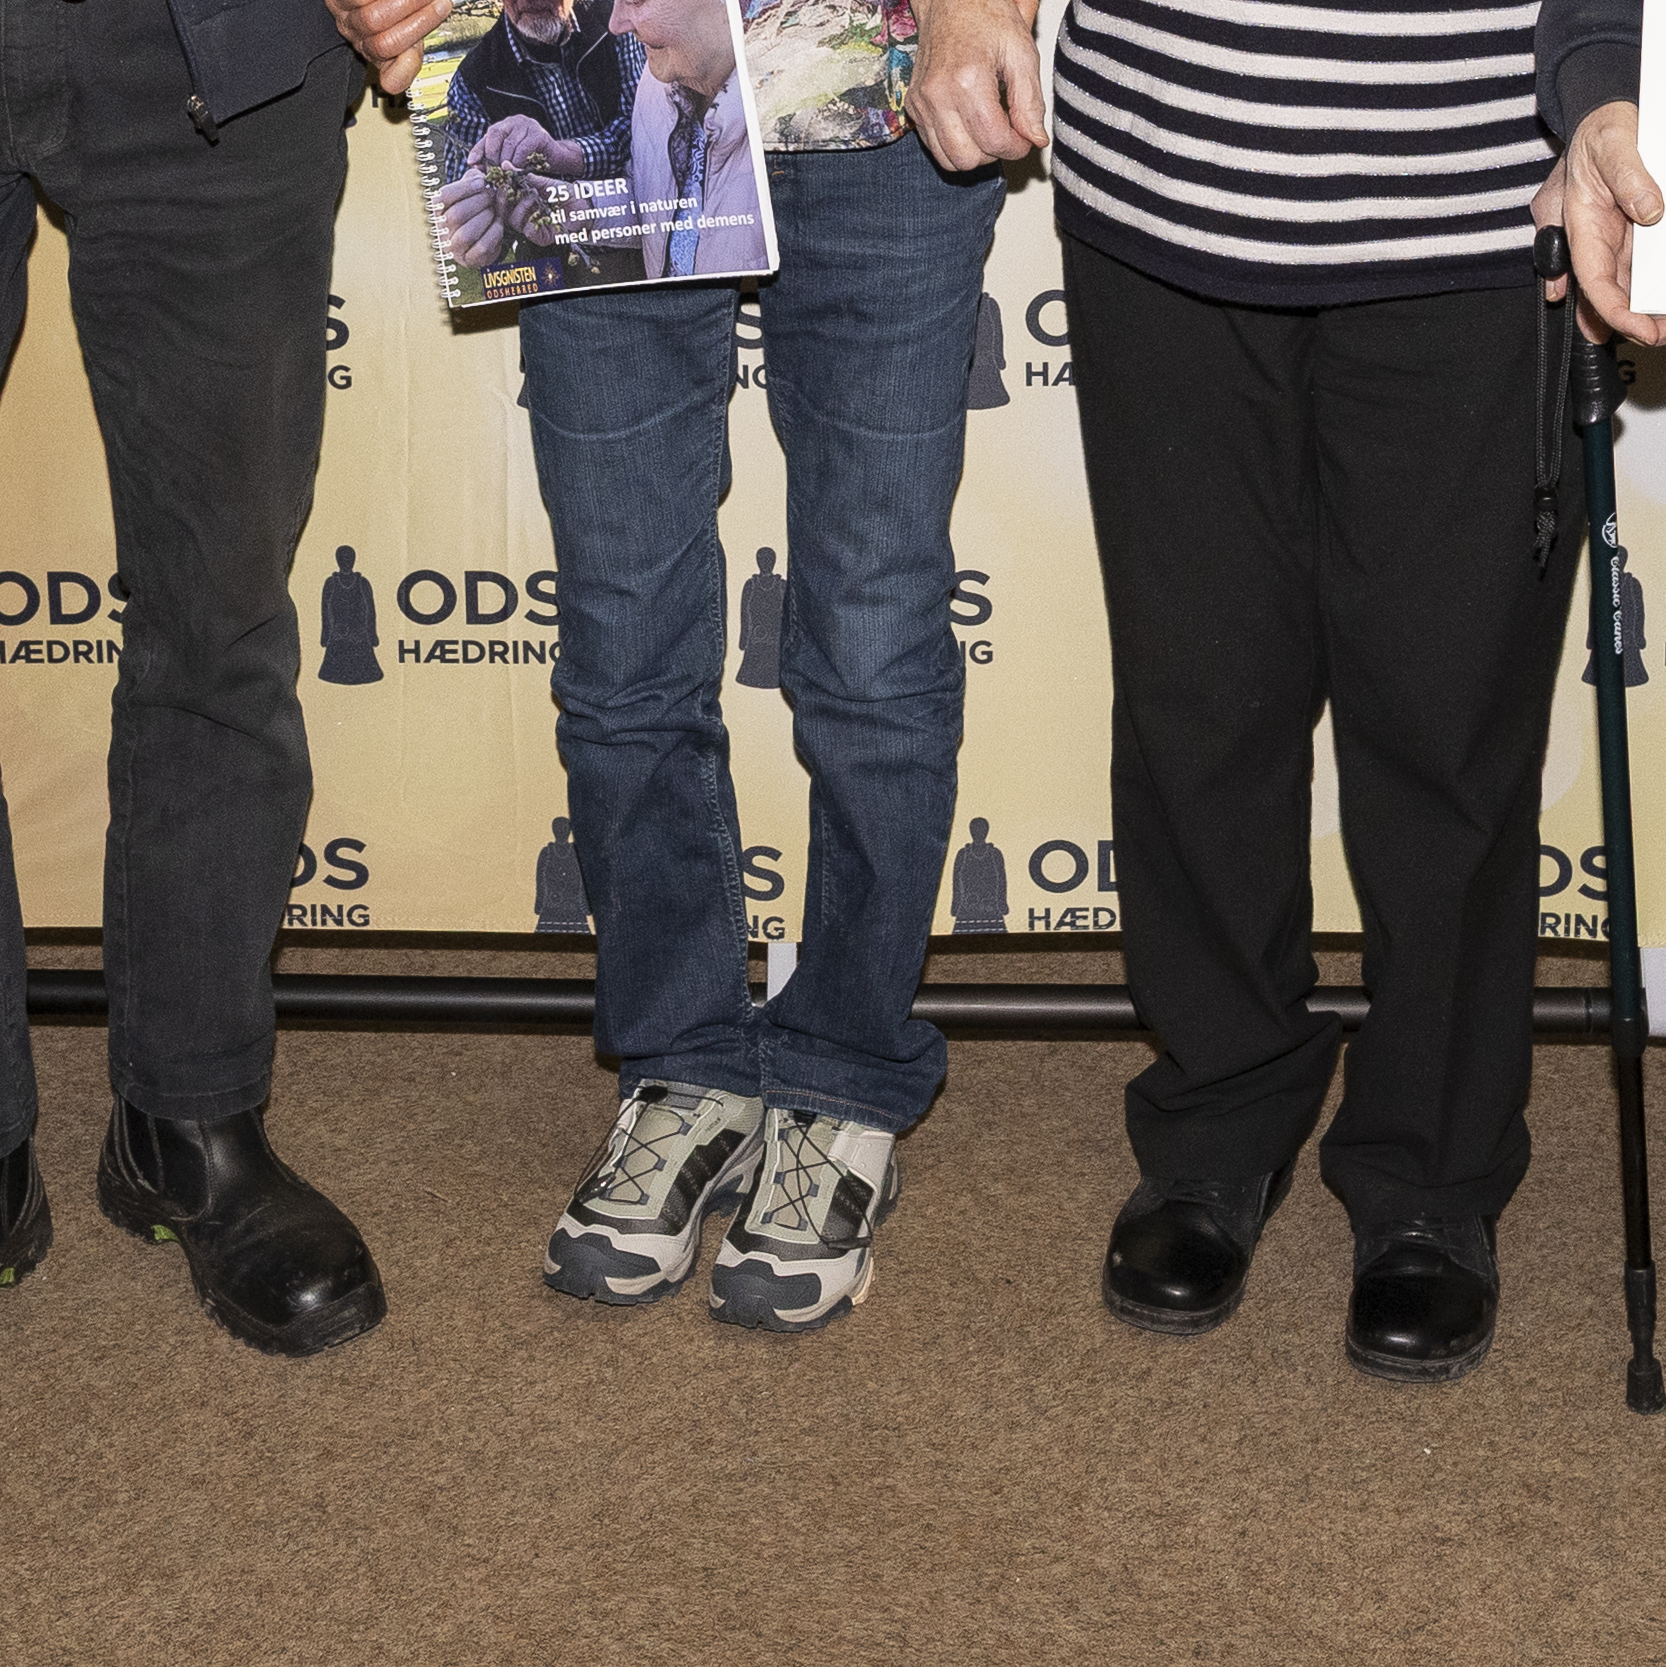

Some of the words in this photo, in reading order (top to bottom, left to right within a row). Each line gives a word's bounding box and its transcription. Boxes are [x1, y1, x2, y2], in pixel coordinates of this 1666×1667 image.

[546, 184, 570, 204] 25
[574, 178, 629, 200] IDEER
[550, 208, 566, 225] til
[570, 203, 628, 222] samvær
[630, 200, 637, 215] i
[639, 197, 698, 214] naturen
[555, 225, 588, 245] med
[591, 222, 657, 243] personer
[660, 214, 694, 233] med
[697, 212, 755, 229] demens
[486, 282, 539, 300] ODSHERRED
[397, 570, 559, 626] ODS
[287, 904, 370, 927] RING
